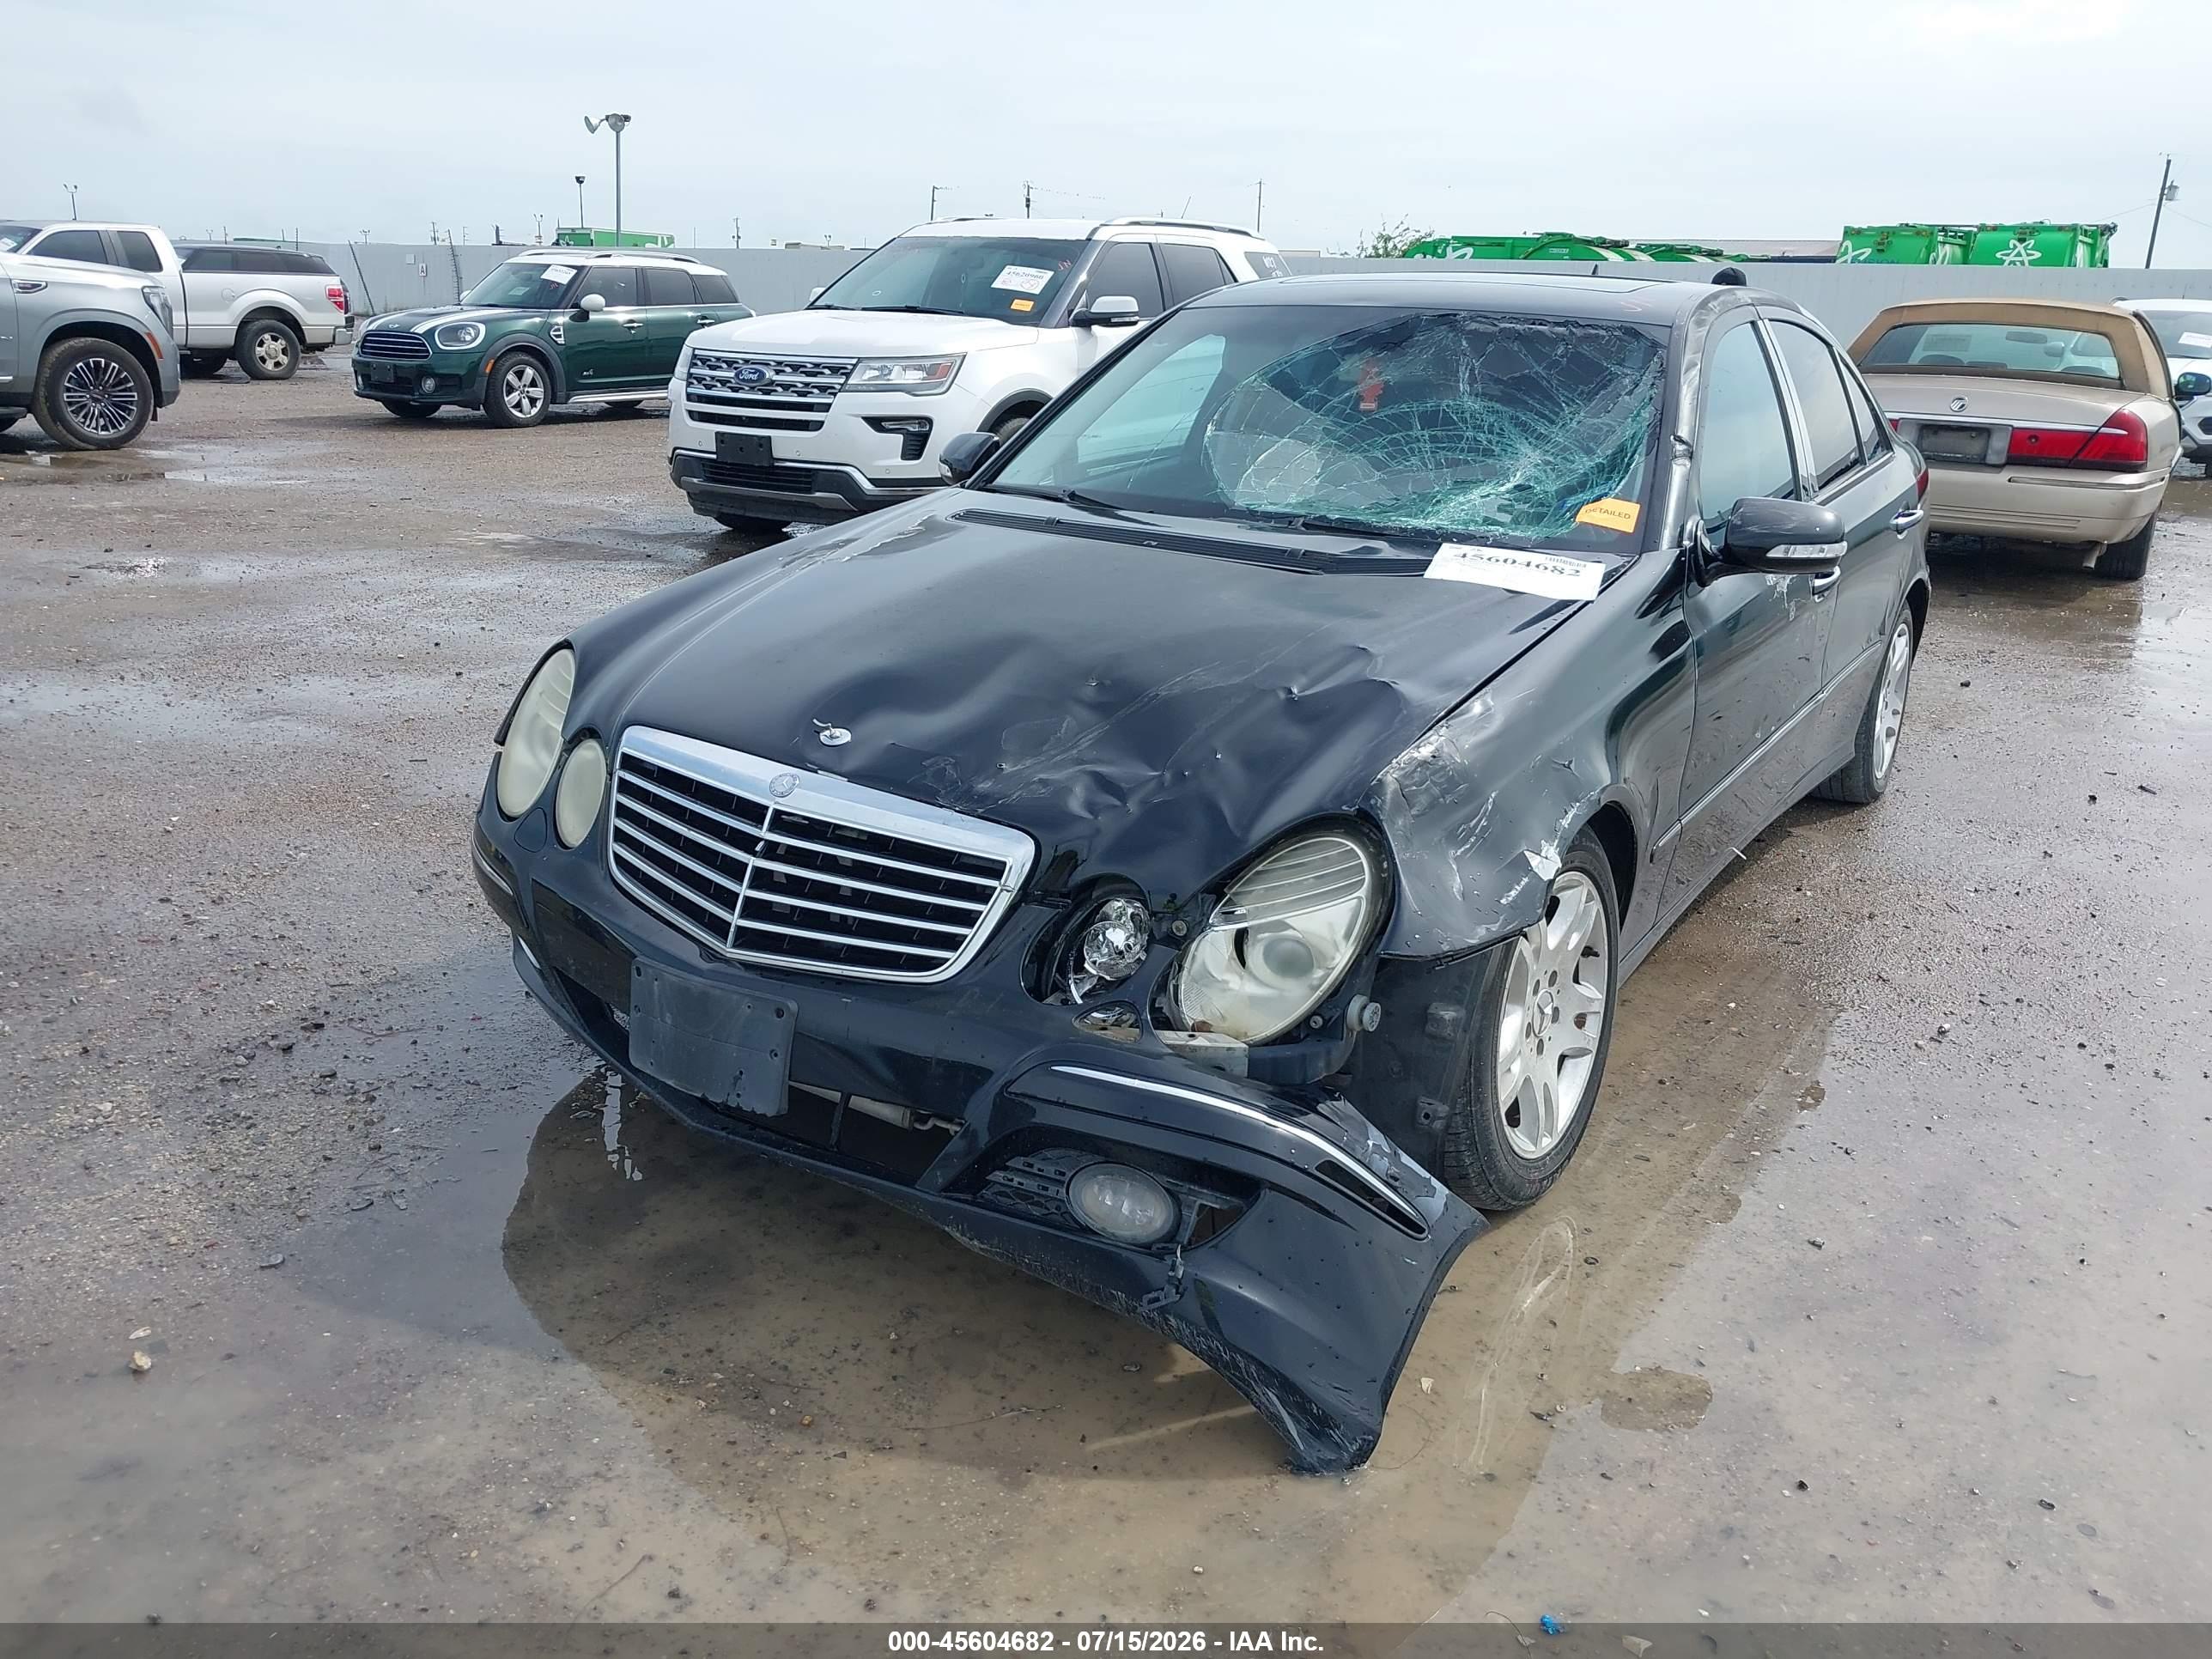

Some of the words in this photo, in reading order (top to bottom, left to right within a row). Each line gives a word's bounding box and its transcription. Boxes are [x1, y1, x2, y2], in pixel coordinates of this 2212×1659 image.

[738, 369, 760, 380] Ford
[1585, 507, 1631, 519] DETAILED
[1453, 552, 1581, 577] 45604682
